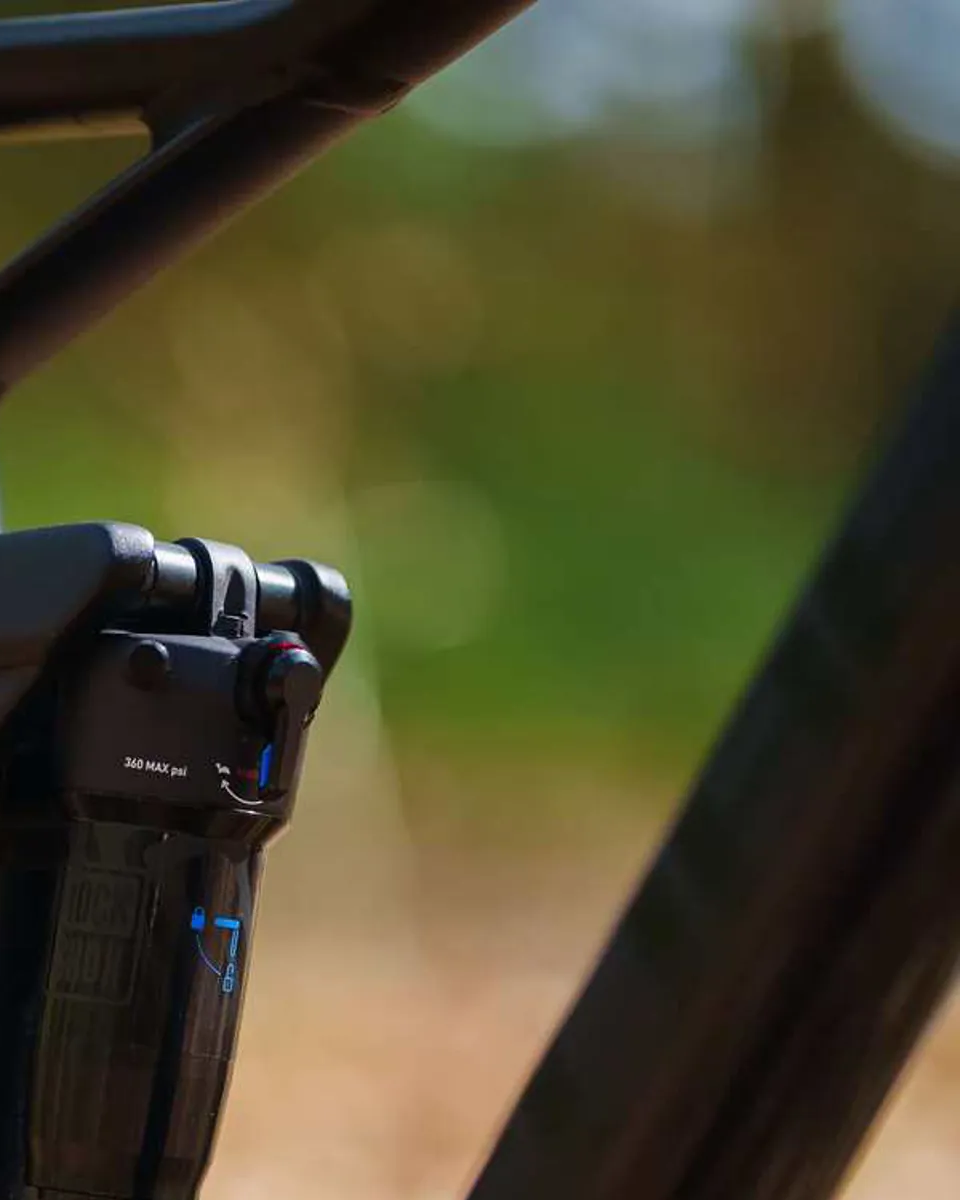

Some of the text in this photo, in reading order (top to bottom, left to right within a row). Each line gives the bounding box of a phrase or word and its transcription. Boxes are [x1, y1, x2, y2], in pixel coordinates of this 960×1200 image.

[123, 756, 188, 778] 360 MAX psi
